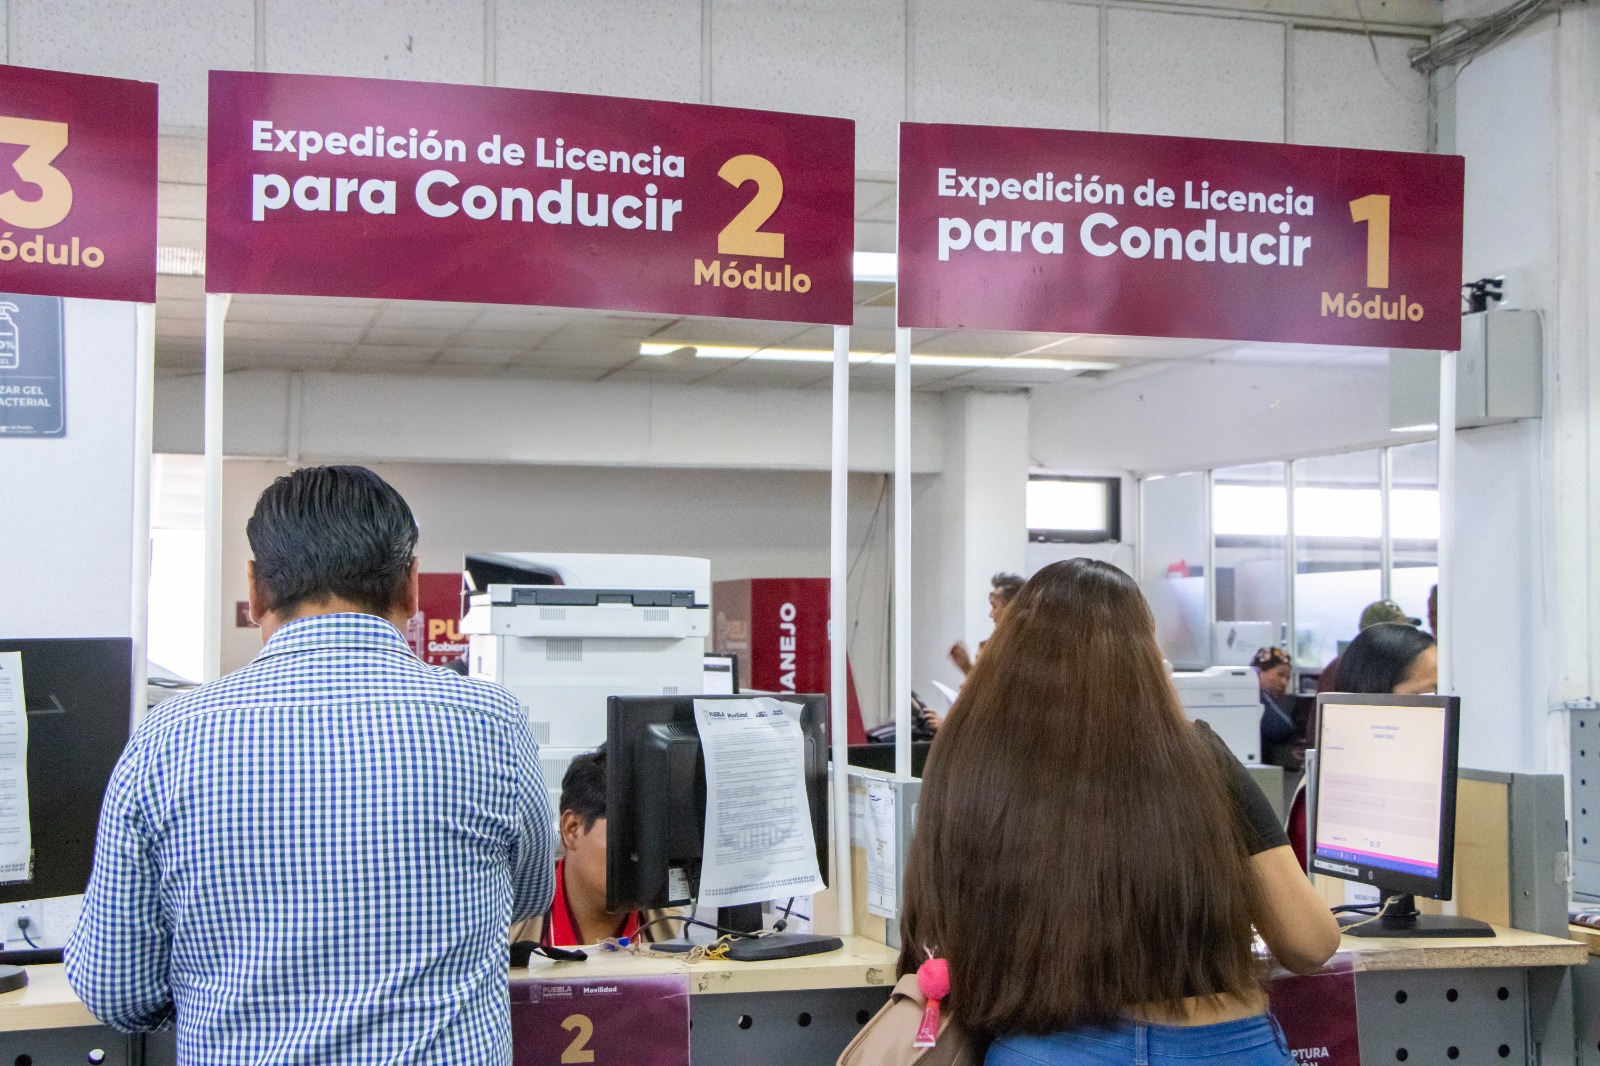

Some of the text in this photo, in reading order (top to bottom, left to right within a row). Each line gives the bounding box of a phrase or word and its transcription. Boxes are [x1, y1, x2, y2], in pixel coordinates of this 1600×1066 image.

[0, 116, 72, 229] 3
[252, 120, 685, 178] Expedición de Licencia
[252, 170, 683, 232] para Conducir
[717, 155, 785, 259] 2
[937, 168, 1314, 215] Expedición de Licencia
[0, 231, 104, 268] ódulo
[937, 212, 1311, 267] para Conducir
[1349, 194, 1390, 289] 1
[694, 258, 812, 293] Módulo
[1321, 291, 1424, 321] Módulo
[0, 386, 44, 395] ZAR GEL
[0, 398, 51, 407] ACTERIAL
[429, 619, 469, 641] PU
[780, 602, 796, 694] ANEJO
[583, 986, 617, 994] Movilidad
[560, 1013, 595, 1064] 2
[1291, 1047, 1329, 1059] PTURA
